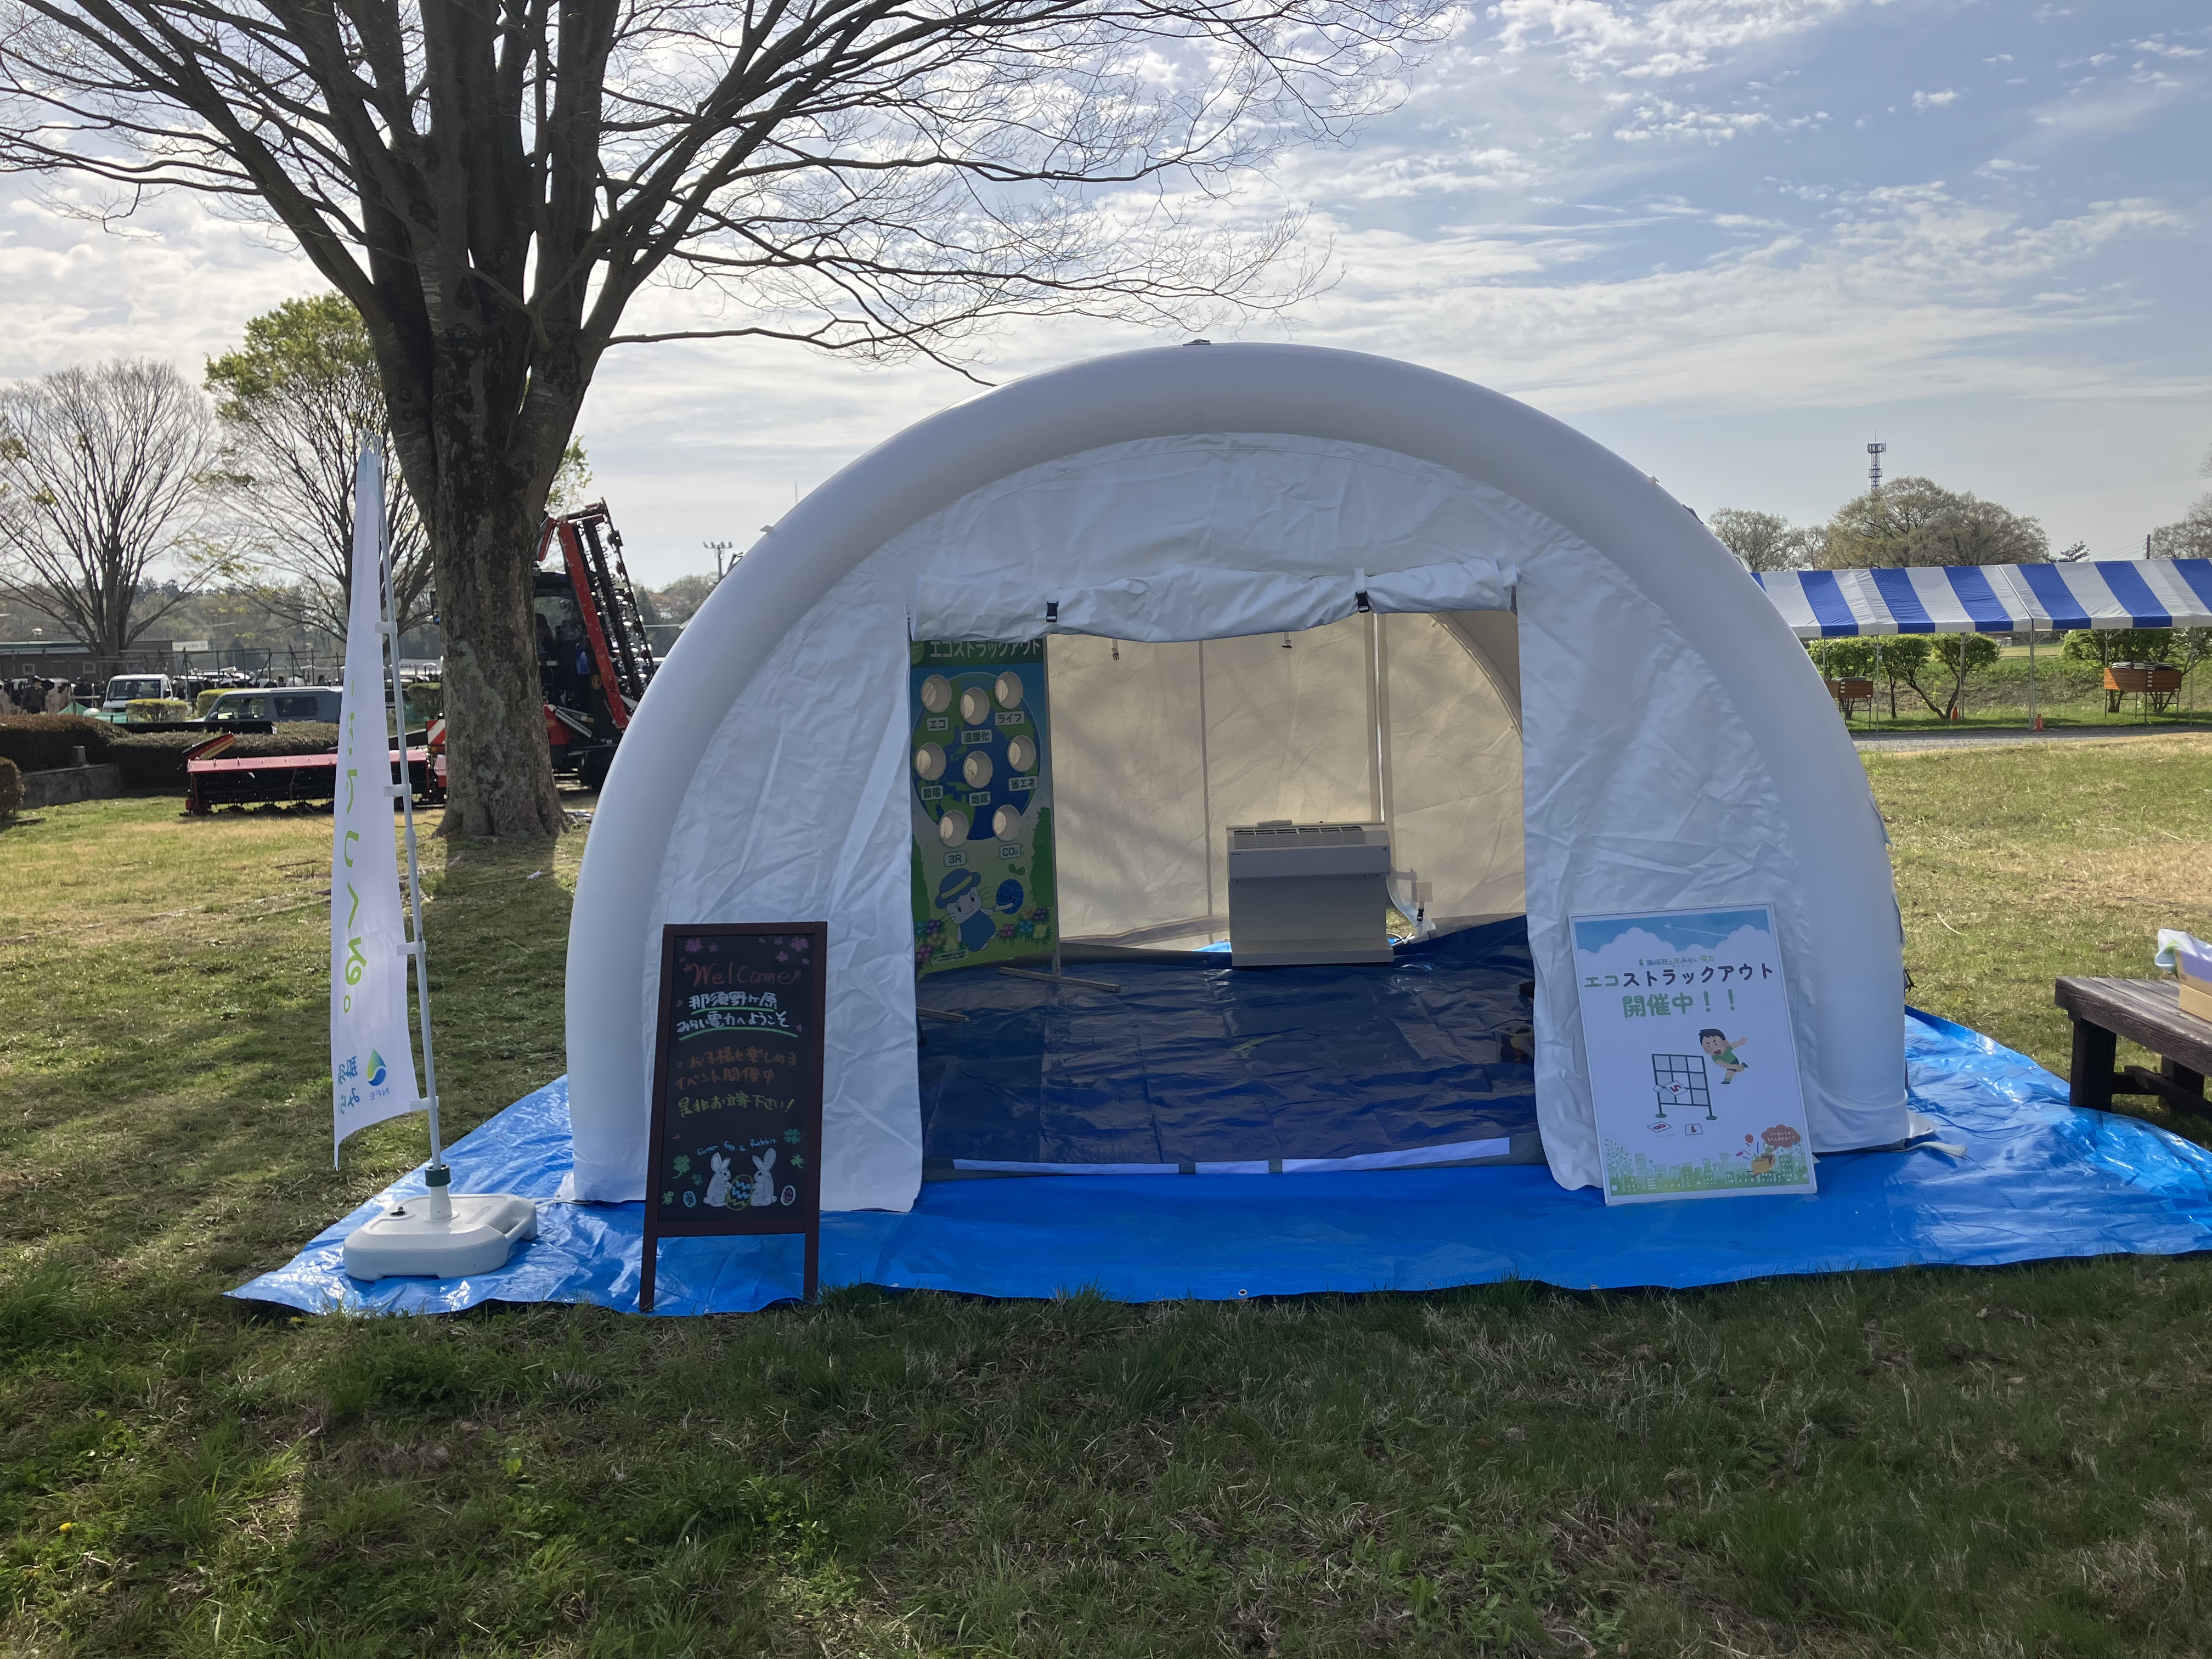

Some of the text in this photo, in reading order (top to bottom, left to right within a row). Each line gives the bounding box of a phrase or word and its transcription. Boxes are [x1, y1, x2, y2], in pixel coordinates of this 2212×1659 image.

[930, 640, 1040, 658] エコストラックアウト
[929, 720, 946, 729] エコ
[997, 714, 1022, 724] ライフ
[964, 731, 989, 743] 温暖化
[1011, 778, 1036, 789] 省エネ
[923, 787, 941, 799] 節電
[971, 793, 989, 804] 地球
[949, 854, 962, 864] 3R
[1584, 963, 1774, 988] エコストラックアウト
[676, 1011, 789, 1032] みらい電力へようこそ
[675, 1066, 775, 1091] イベント開催中
[724, 1141, 736, 1152] Egg
[750, 1137, 777, 1148] Rabbit
